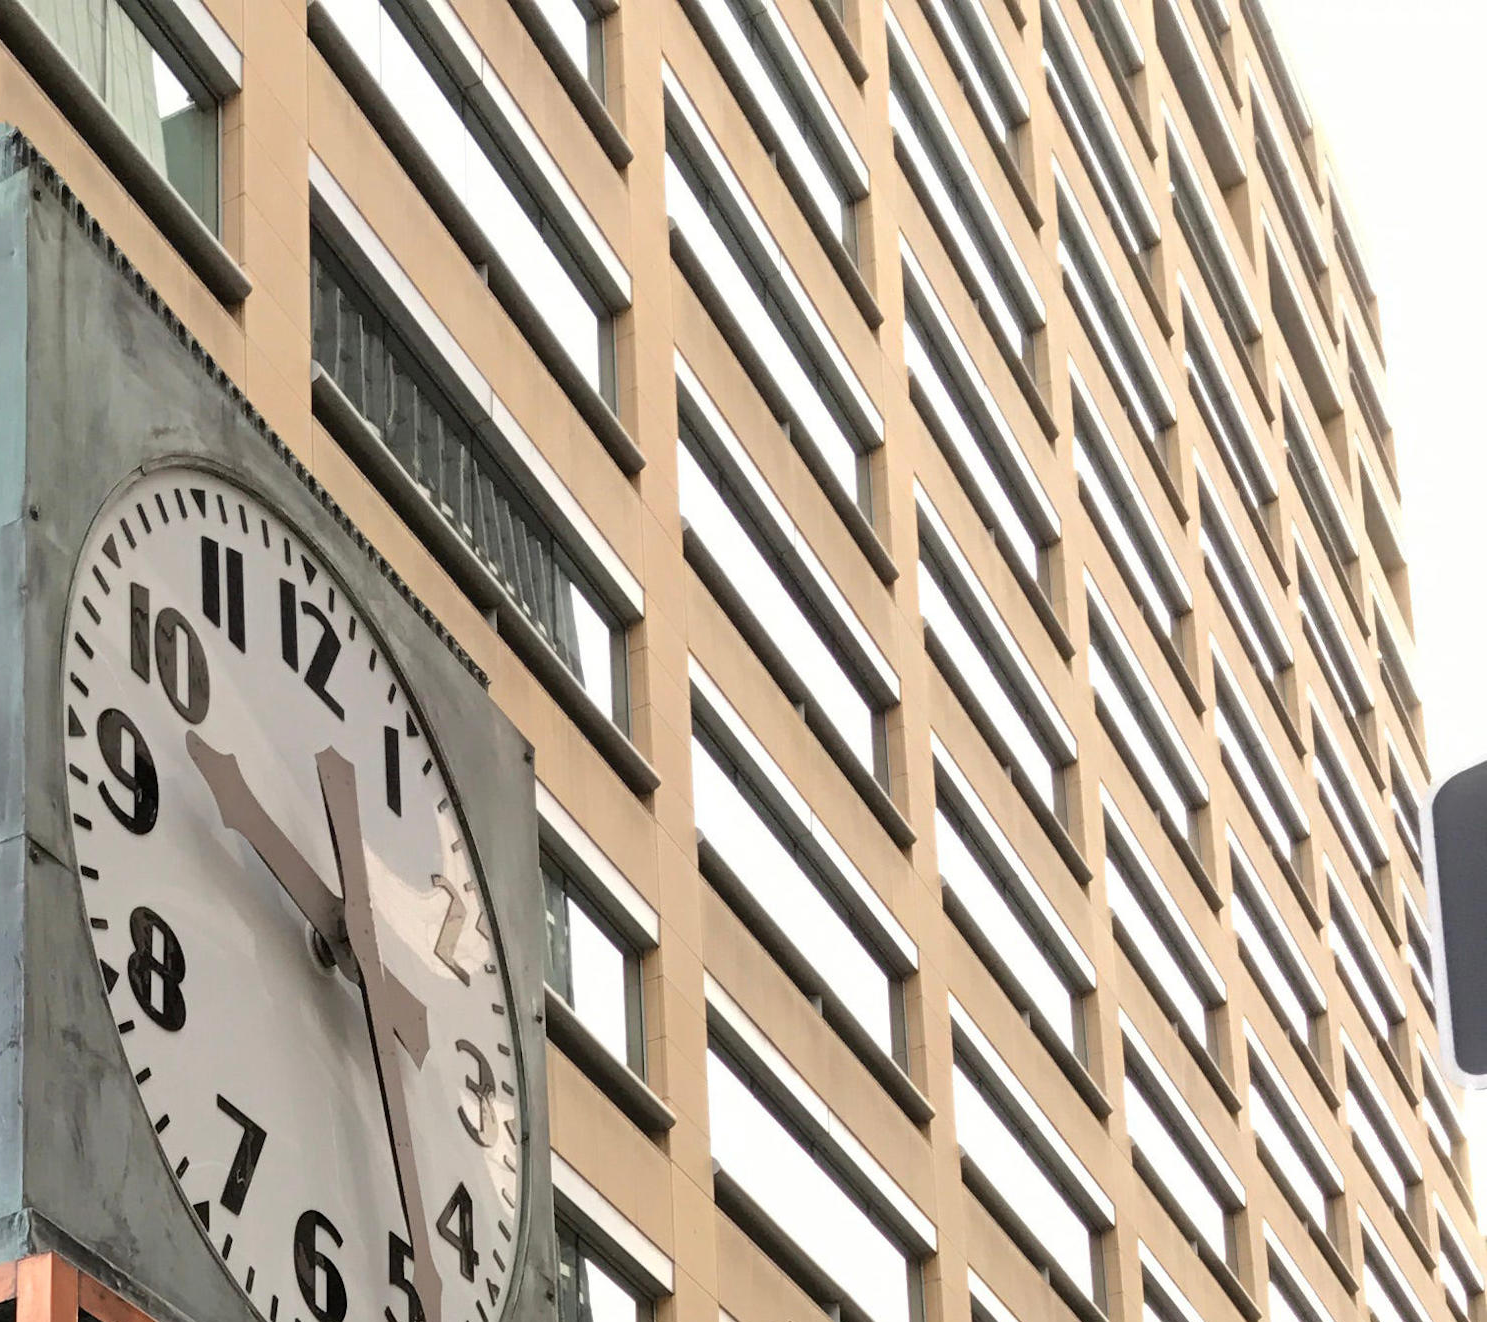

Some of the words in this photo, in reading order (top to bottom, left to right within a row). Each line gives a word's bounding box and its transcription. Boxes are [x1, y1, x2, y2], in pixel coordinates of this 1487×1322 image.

[129, 581, 211, 726] 10
[199, 535, 247, 655] 11
[278, 577, 346, 723] 12
[96, 707, 160, 837] 9
[384, 725, 402, 819] 1
[126, 905, 188, 1033] 8
[430, 872, 471, 987] 2
[215, 1092, 268, 1218] 7
[455, 1038, 497, 1149] 3
[435, 1180, 481, 1284] 4
